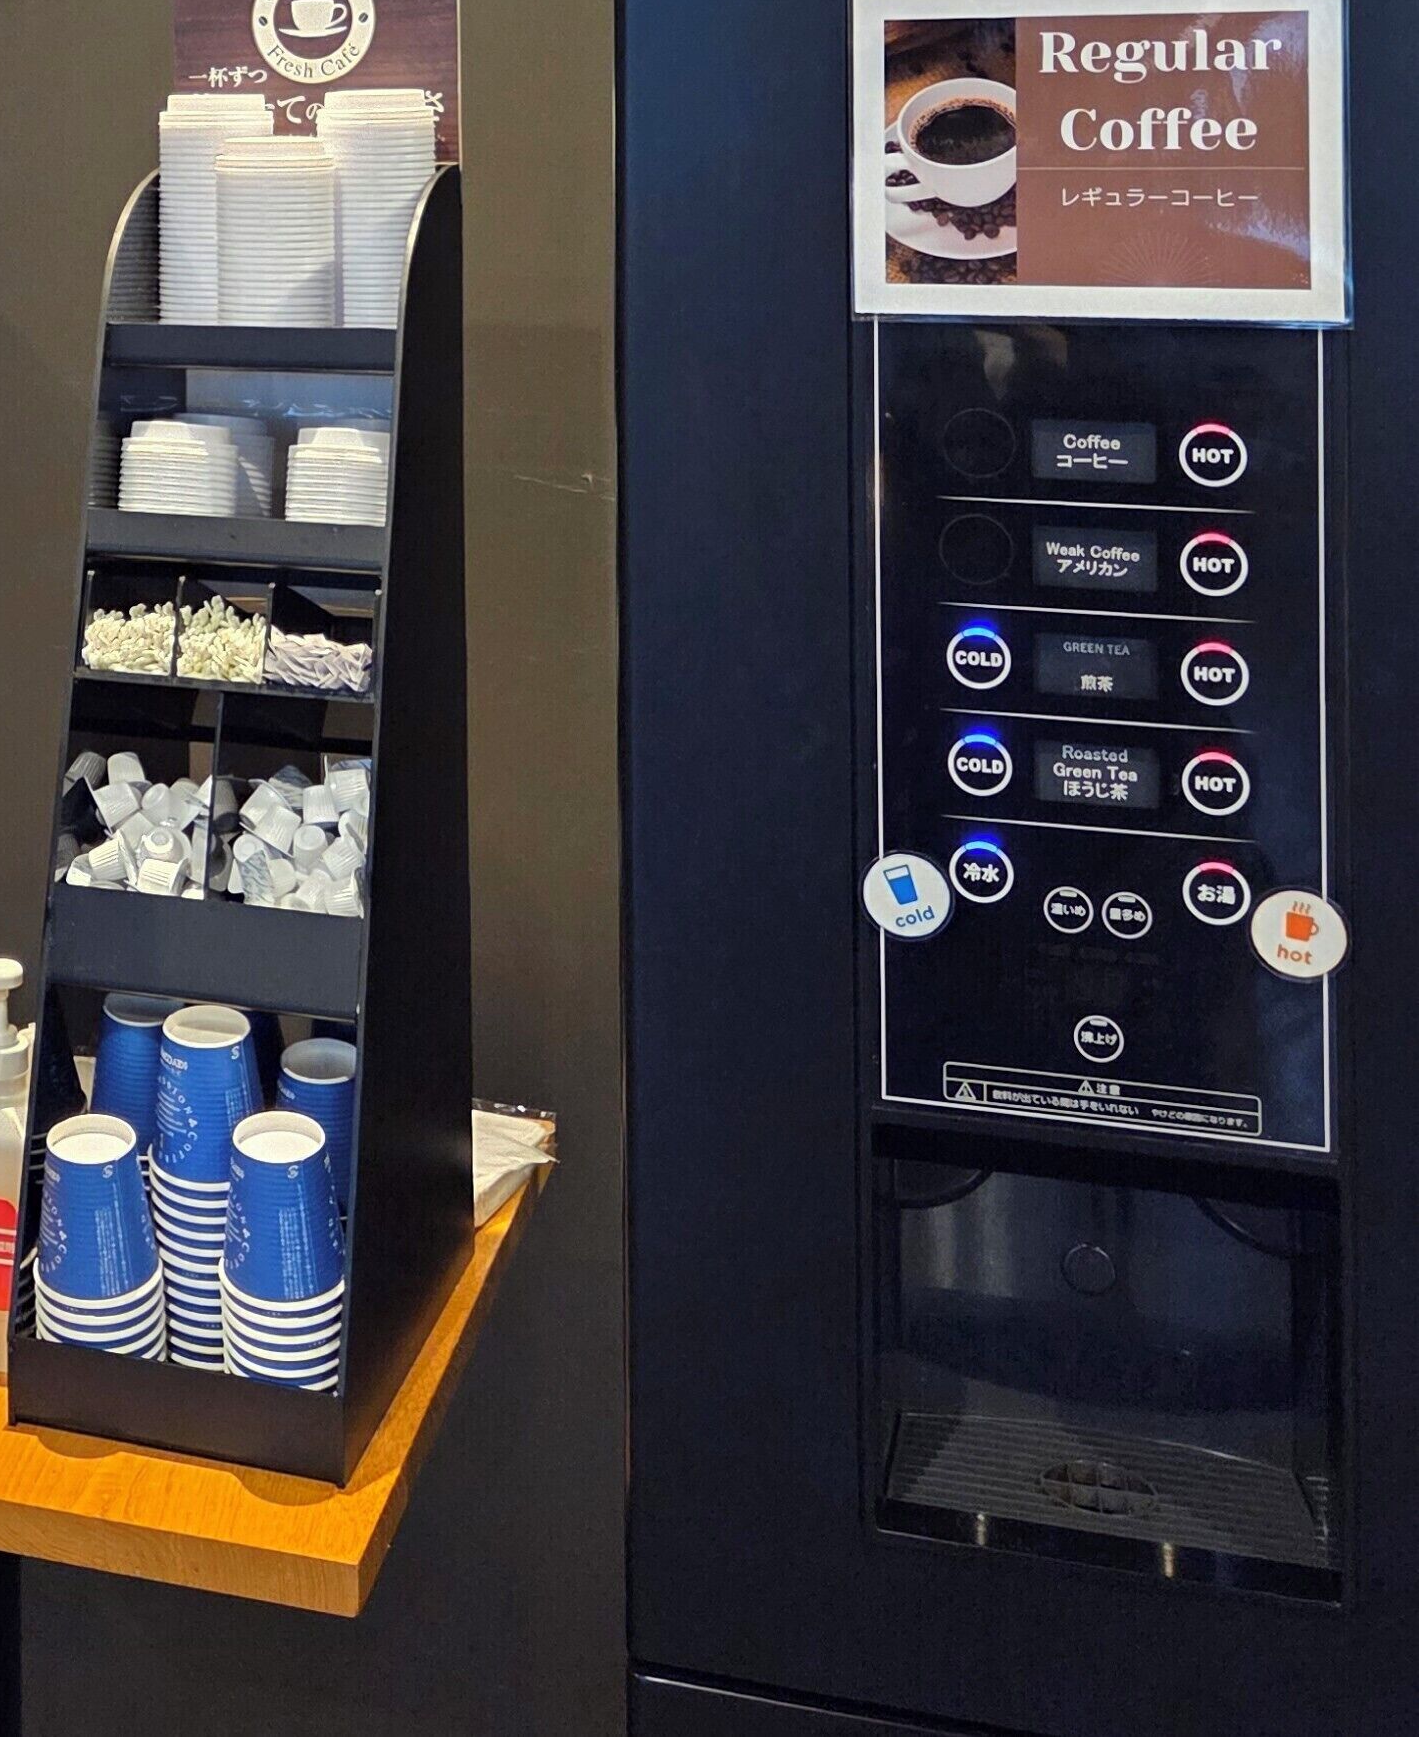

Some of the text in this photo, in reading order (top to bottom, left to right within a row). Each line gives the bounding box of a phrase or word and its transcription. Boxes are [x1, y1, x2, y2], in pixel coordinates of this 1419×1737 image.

[267, 42, 360, 78] Fresh Café
[1039, 29, 1282, 84] Regular
[189, 66, 268, 88] 一杯ずつ
[1060, 108, 1258, 151] Coffee
[1060, 187, 1259, 207] レギュラーコーヒー
[1063, 433, 1121, 450] Coffee
[1056, 452, 1129, 469] コーヒー
[1192, 447, 1234, 465] HOT
[1046, 541, 1140, 562] Weak Coffee
[1056, 559, 1128, 577] アメリカン
[1193, 556, 1235, 574] HOT
[954, 649, 1003, 668] COLD
[1063, 641, 1131, 656] GREEN TEA
[1080, 674, 1114, 692] 煎茶
[1193, 665, 1236, 684] HOT
[1062, 745, 1129, 763] Roasted
[955, 756, 1004, 776] COLD
[1052, 762, 1138, 782] Green Tea
[1063, 779, 1129, 802] ほうじ茶
[1194, 774, 1237, 793] HOT
[962, 863, 1000, 883] 冷水
[1197, 884, 1236, 905] お湯
[895, 906, 936, 929] cold
[1276, 943, 1313, 966] hot
